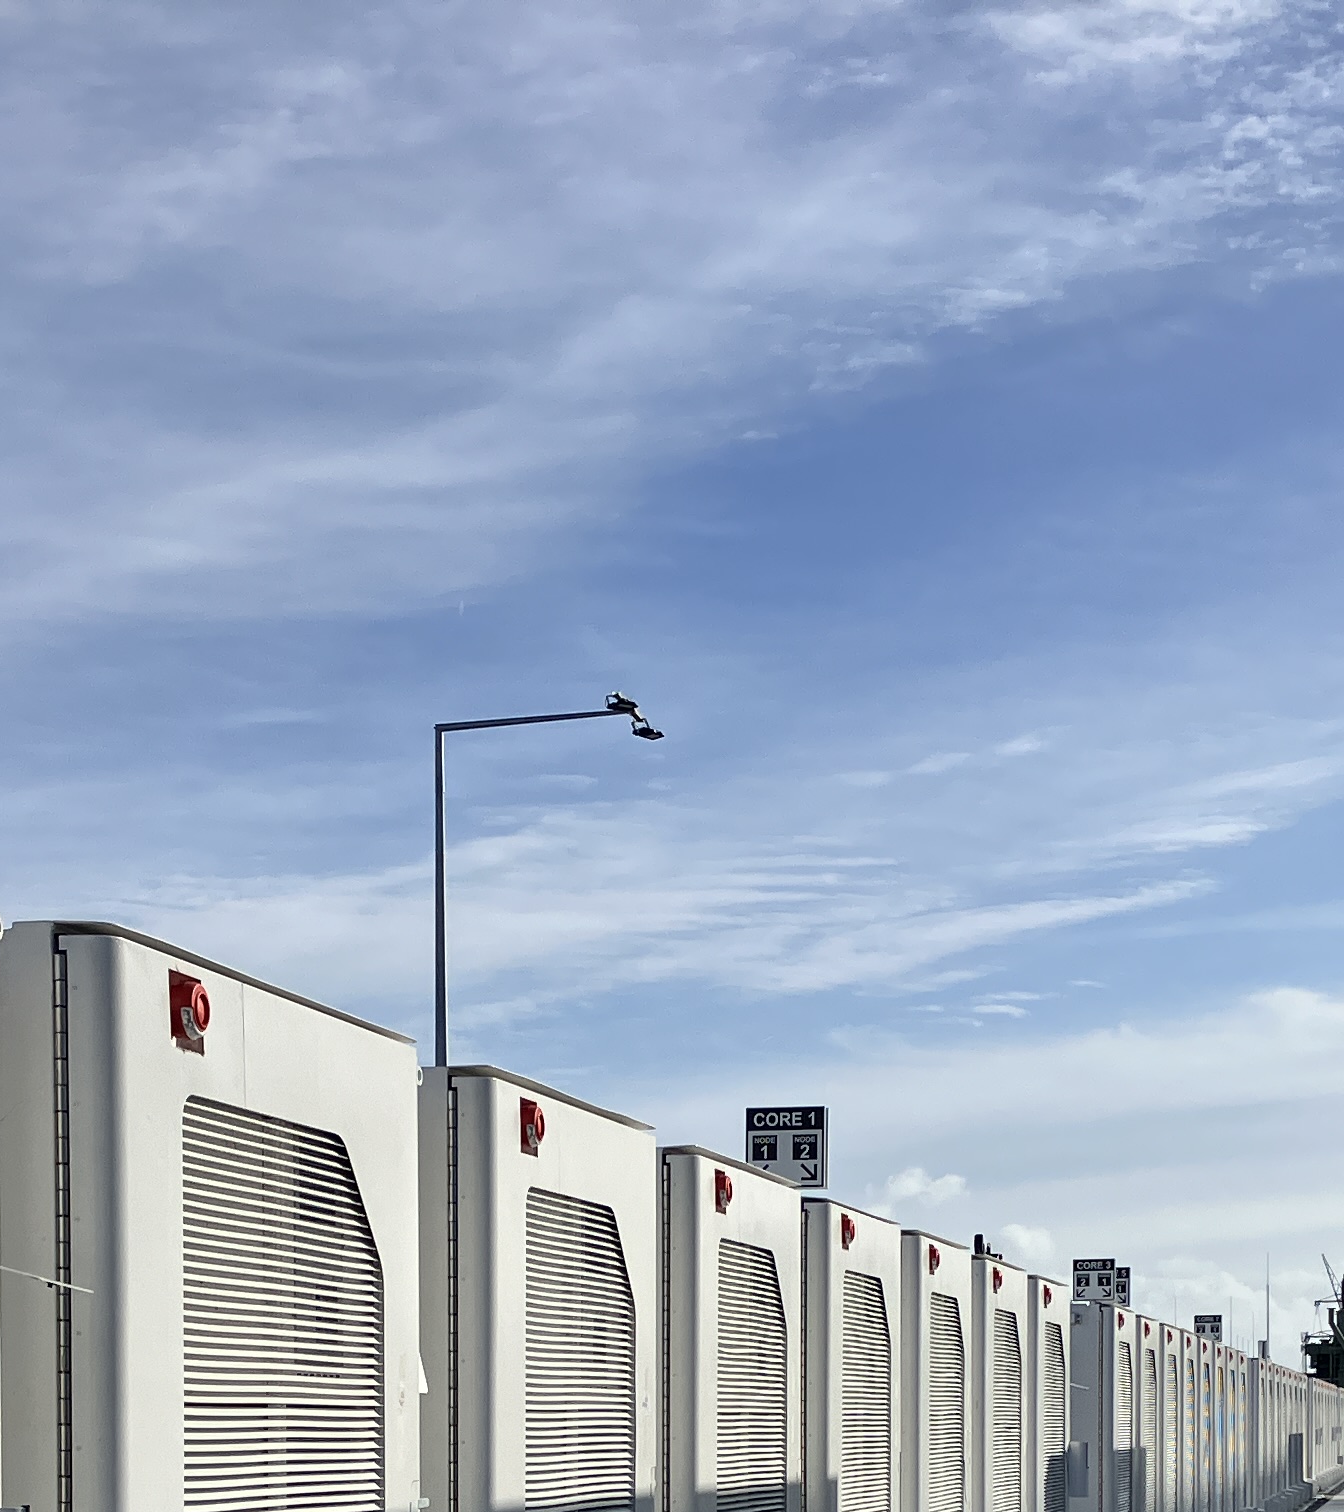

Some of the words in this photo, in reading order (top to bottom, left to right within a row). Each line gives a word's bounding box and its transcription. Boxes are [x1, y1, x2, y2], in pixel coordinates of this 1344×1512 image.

[753, 1111, 803, 1127] CORE
[807, 1111, 815, 1126] 1
[754, 1136, 776, 1144] NODE
[760, 1145, 768, 1159] 1
[799, 1144, 810, 1159] 2
[1076, 1261, 1104, 1270] CORE
[1105, 1261, 1112, 1270] 3
[1080, 1278, 1086, 1287] 2
[1102, 1278, 1107, 1286] 1
